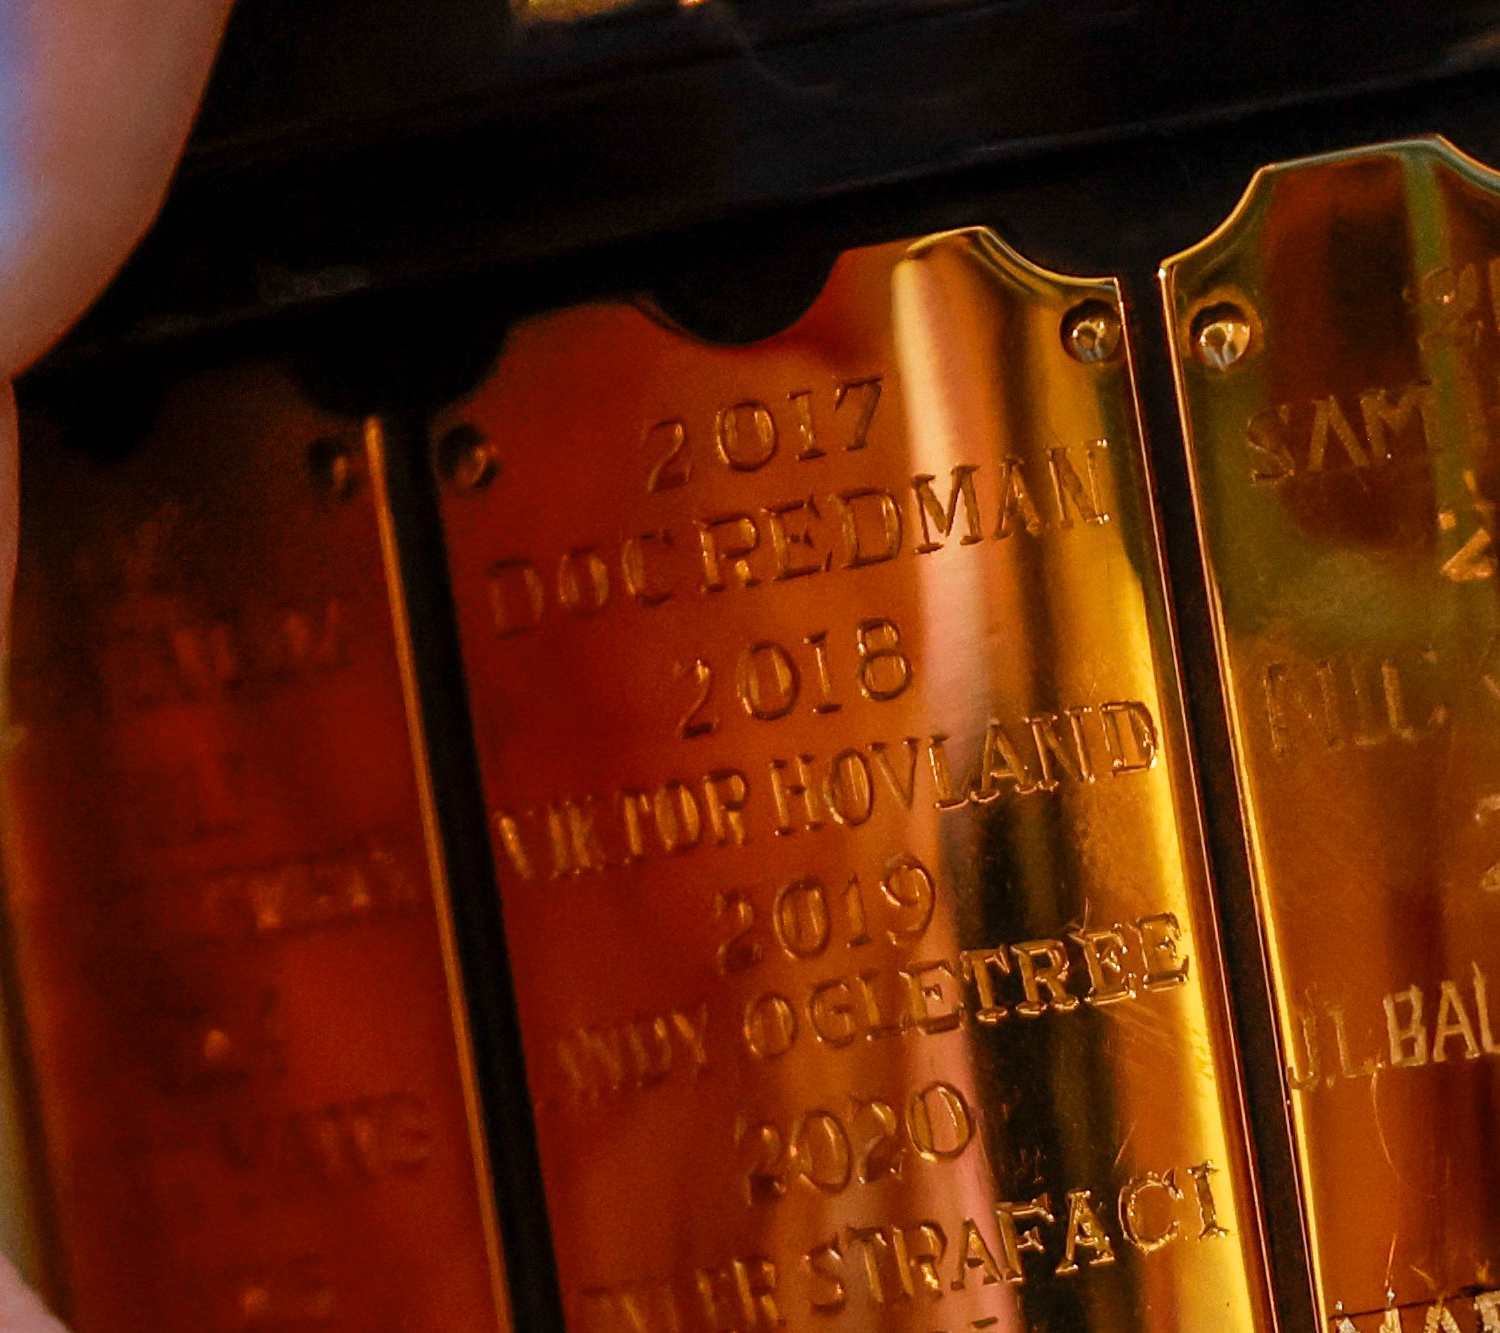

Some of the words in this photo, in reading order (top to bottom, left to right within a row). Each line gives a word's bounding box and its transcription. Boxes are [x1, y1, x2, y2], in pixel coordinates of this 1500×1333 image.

[640, 376, 884, 494] 2017
[490, 530, 675, 640] DOC
[698, 440, 1112, 594] REDMAN
[672, 616, 915, 740] 2018
[770, 698, 1160, 838] HOVLAND
[714, 854, 937, 976] 2019
[740, 911, 1192, 1060] OGLETREE
[736, 1081, 974, 1206] 2020
[802, 1159, 1230, 1316] STRAFACI
